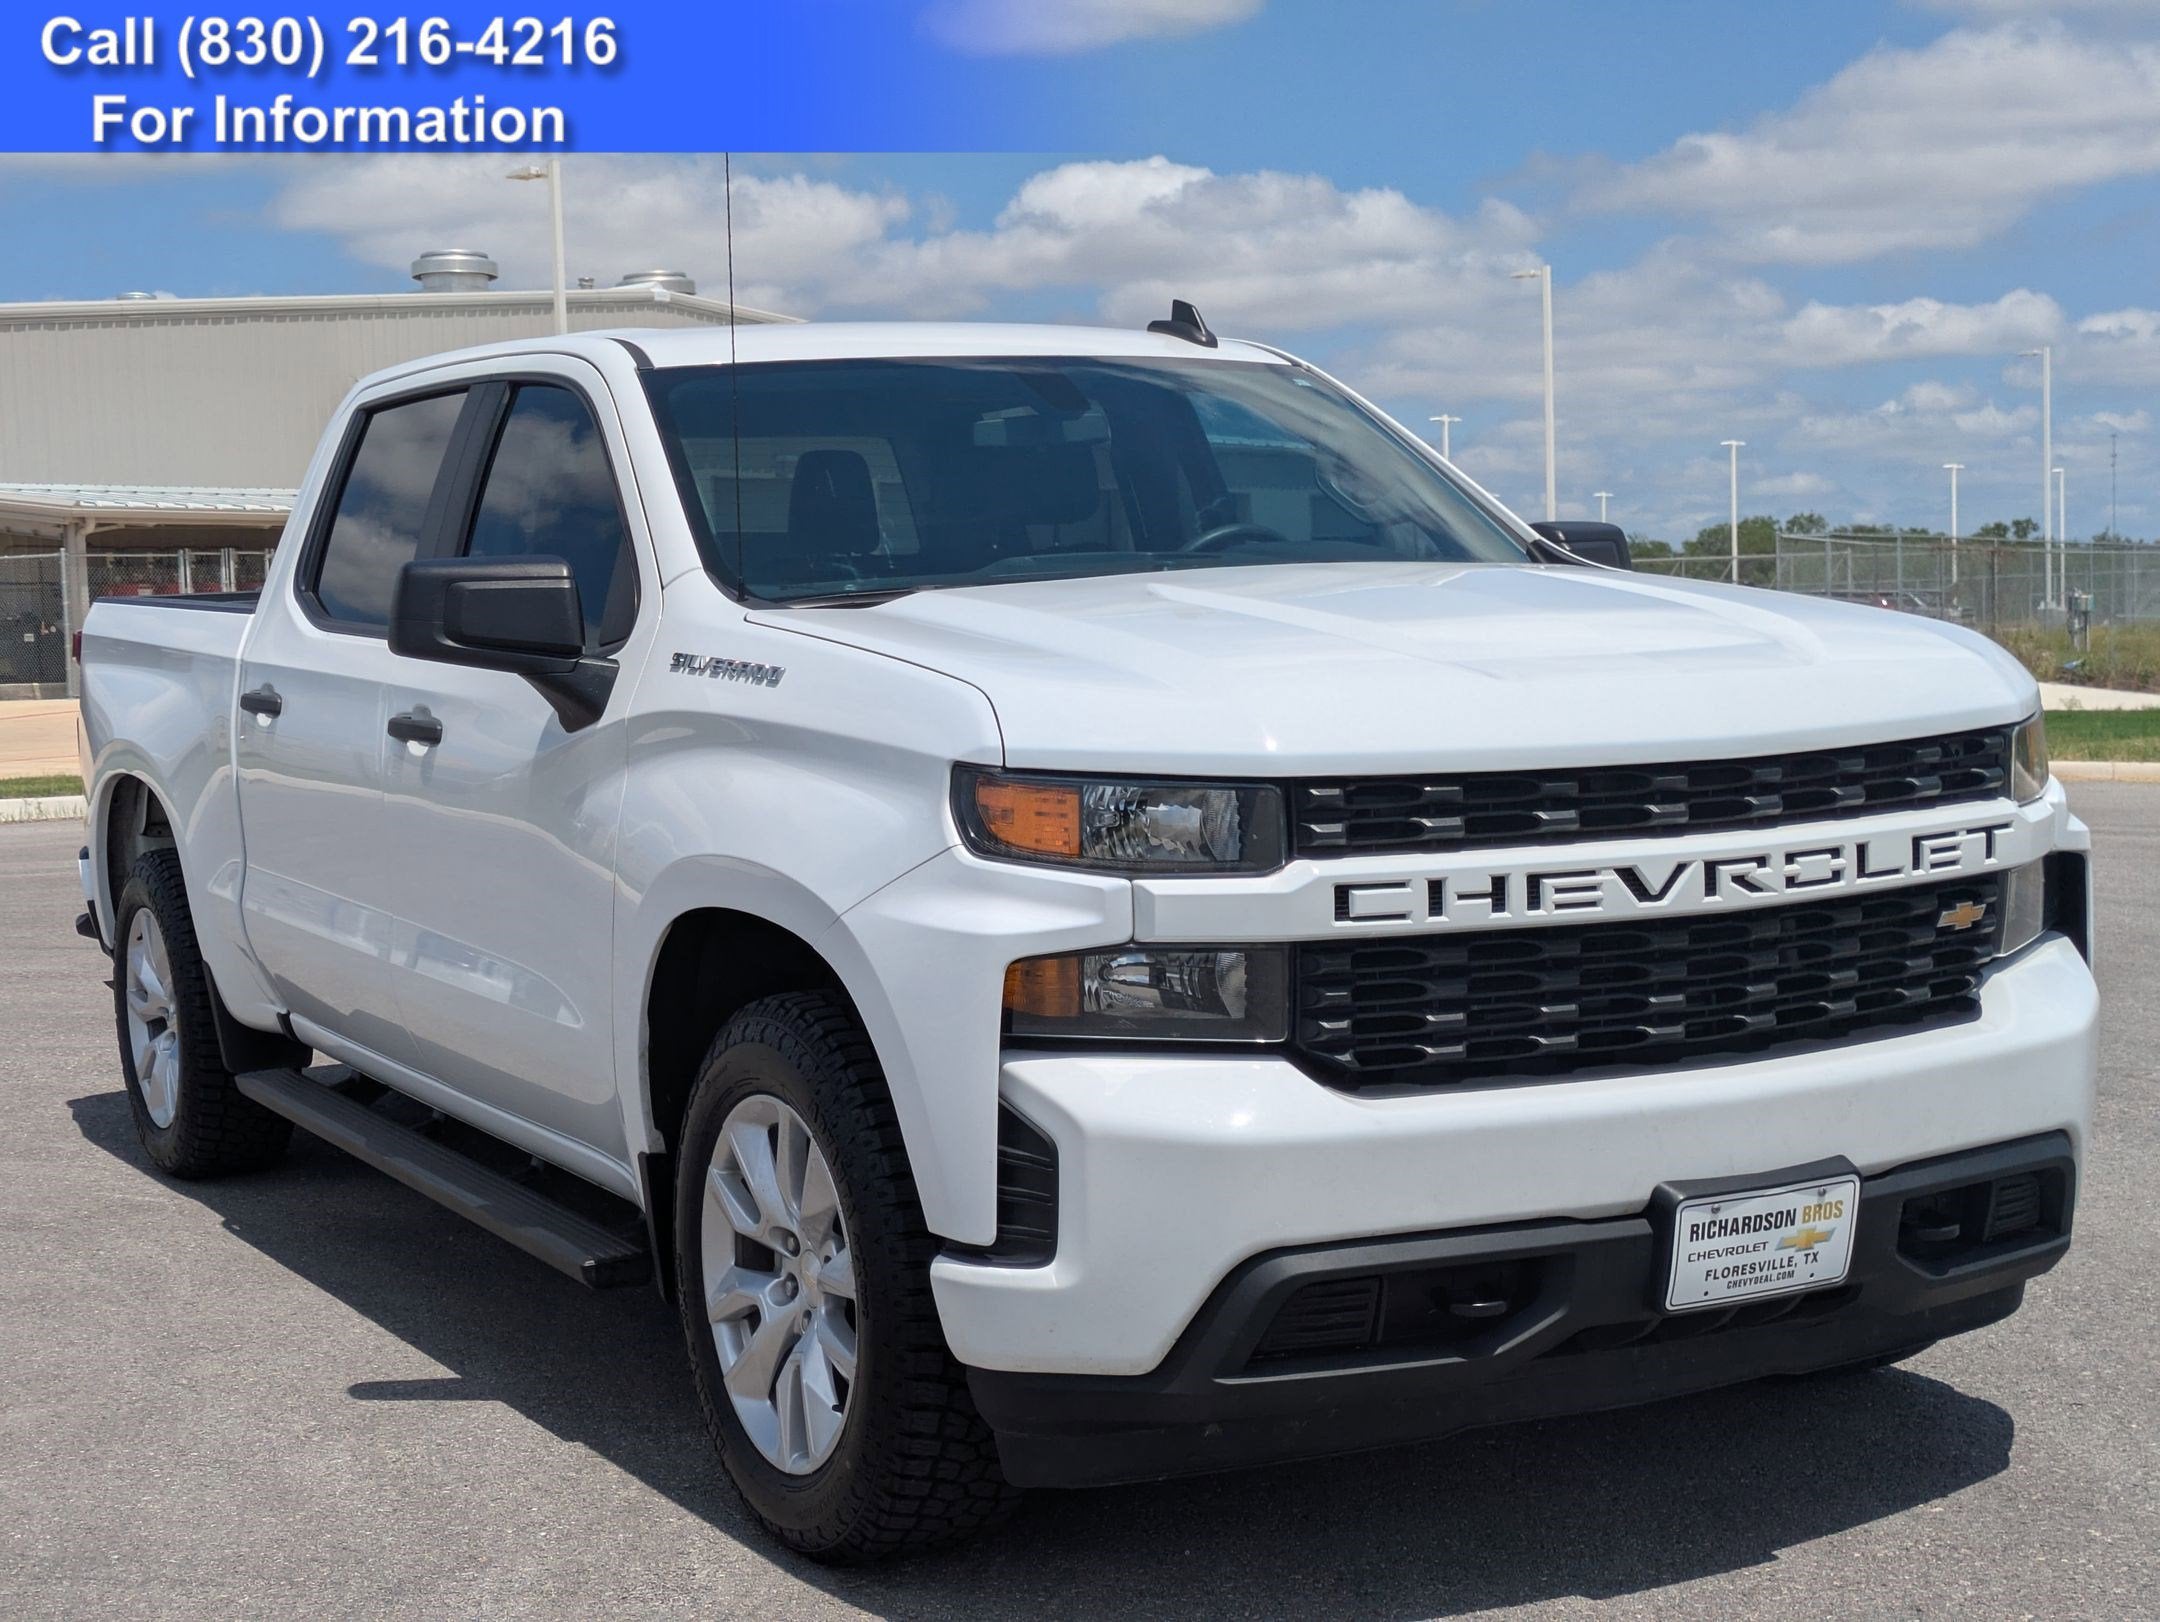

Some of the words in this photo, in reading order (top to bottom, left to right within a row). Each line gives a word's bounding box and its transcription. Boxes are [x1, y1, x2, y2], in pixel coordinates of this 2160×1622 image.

[670, 652, 786, 688] SILVERADO
[1333, 822, 2013, 925] CHEVROLET
[1689, 1208, 1797, 1242] RICHARDSON
[1802, 1200, 1844, 1224] BROS
[1688, 1241, 1769, 1262] CHEVROLET
[1705, 1256, 1798, 1281] FLORESVILLE,
[1804, 1251, 1819, 1265] TX
[1727, 1270, 1795, 1289] CHEVYDEAL.COM
